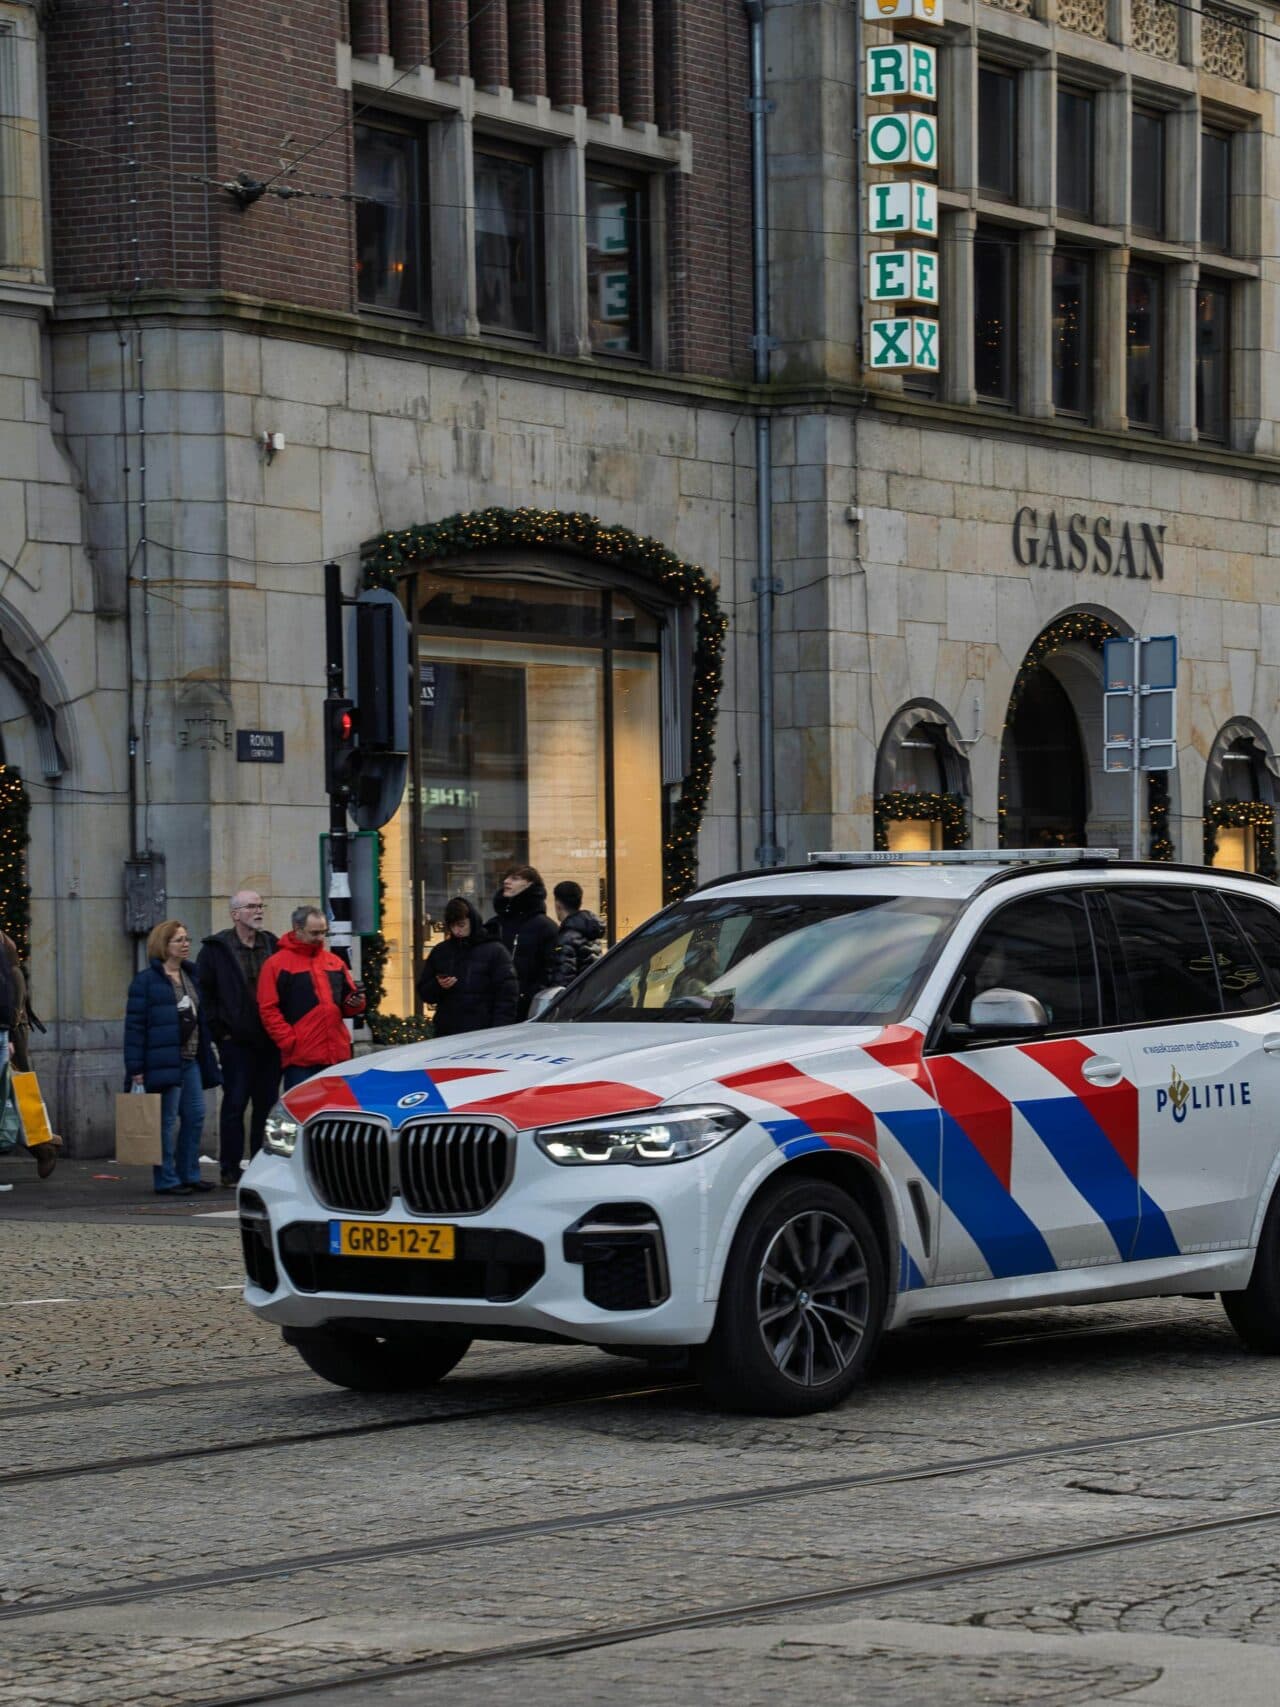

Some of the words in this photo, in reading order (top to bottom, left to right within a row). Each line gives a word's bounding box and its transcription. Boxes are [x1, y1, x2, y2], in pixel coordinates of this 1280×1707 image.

[871, 49, 908, 365] ROLEX
[913, 49, 937, 367] ROLEX
[1012, 506, 1168, 580] GASSAN
[1157, 1082, 1251, 1123] POLITIE
[348, 1227, 442, 1254] GRB-12-Z
